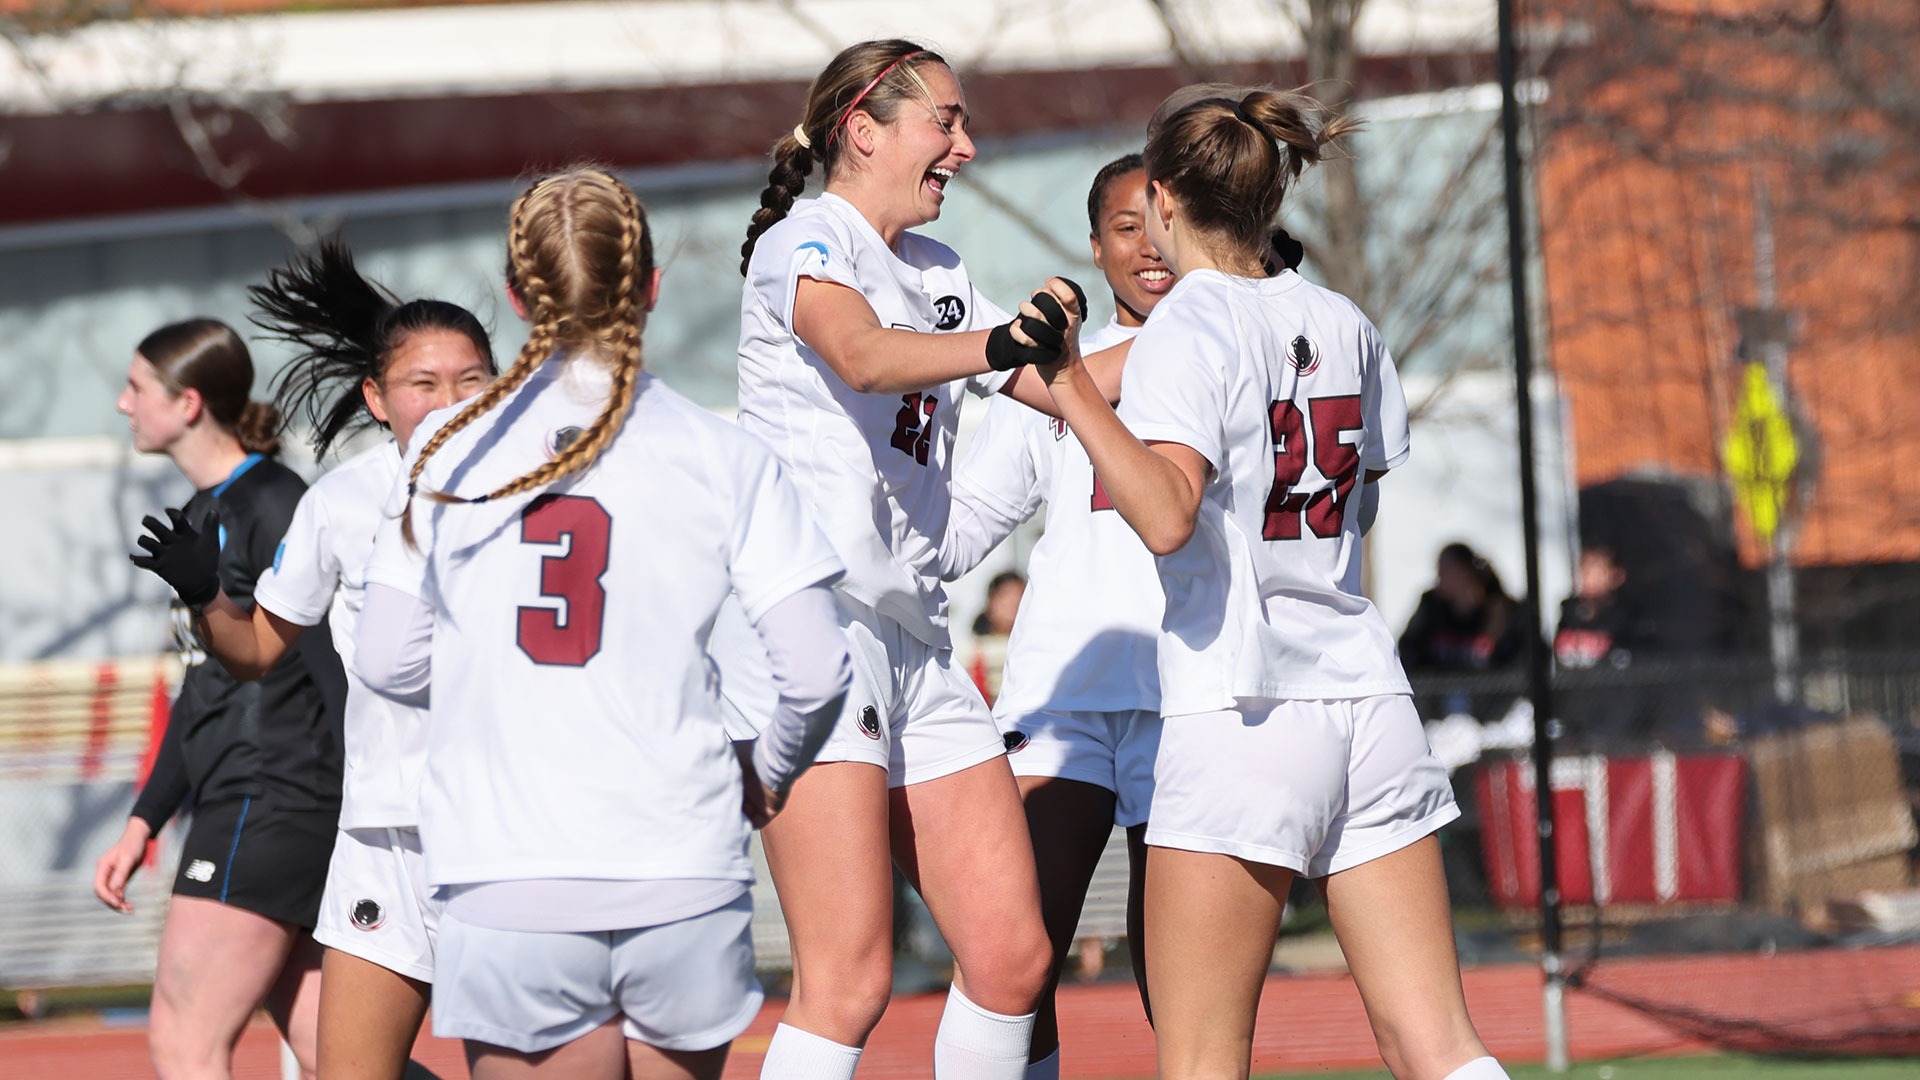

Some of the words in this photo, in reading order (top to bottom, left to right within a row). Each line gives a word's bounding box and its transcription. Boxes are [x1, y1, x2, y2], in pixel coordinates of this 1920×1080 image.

[935, 299, 962, 325] 24
[1262, 394, 1363, 541] 25
[516, 493, 612, 667] 3
